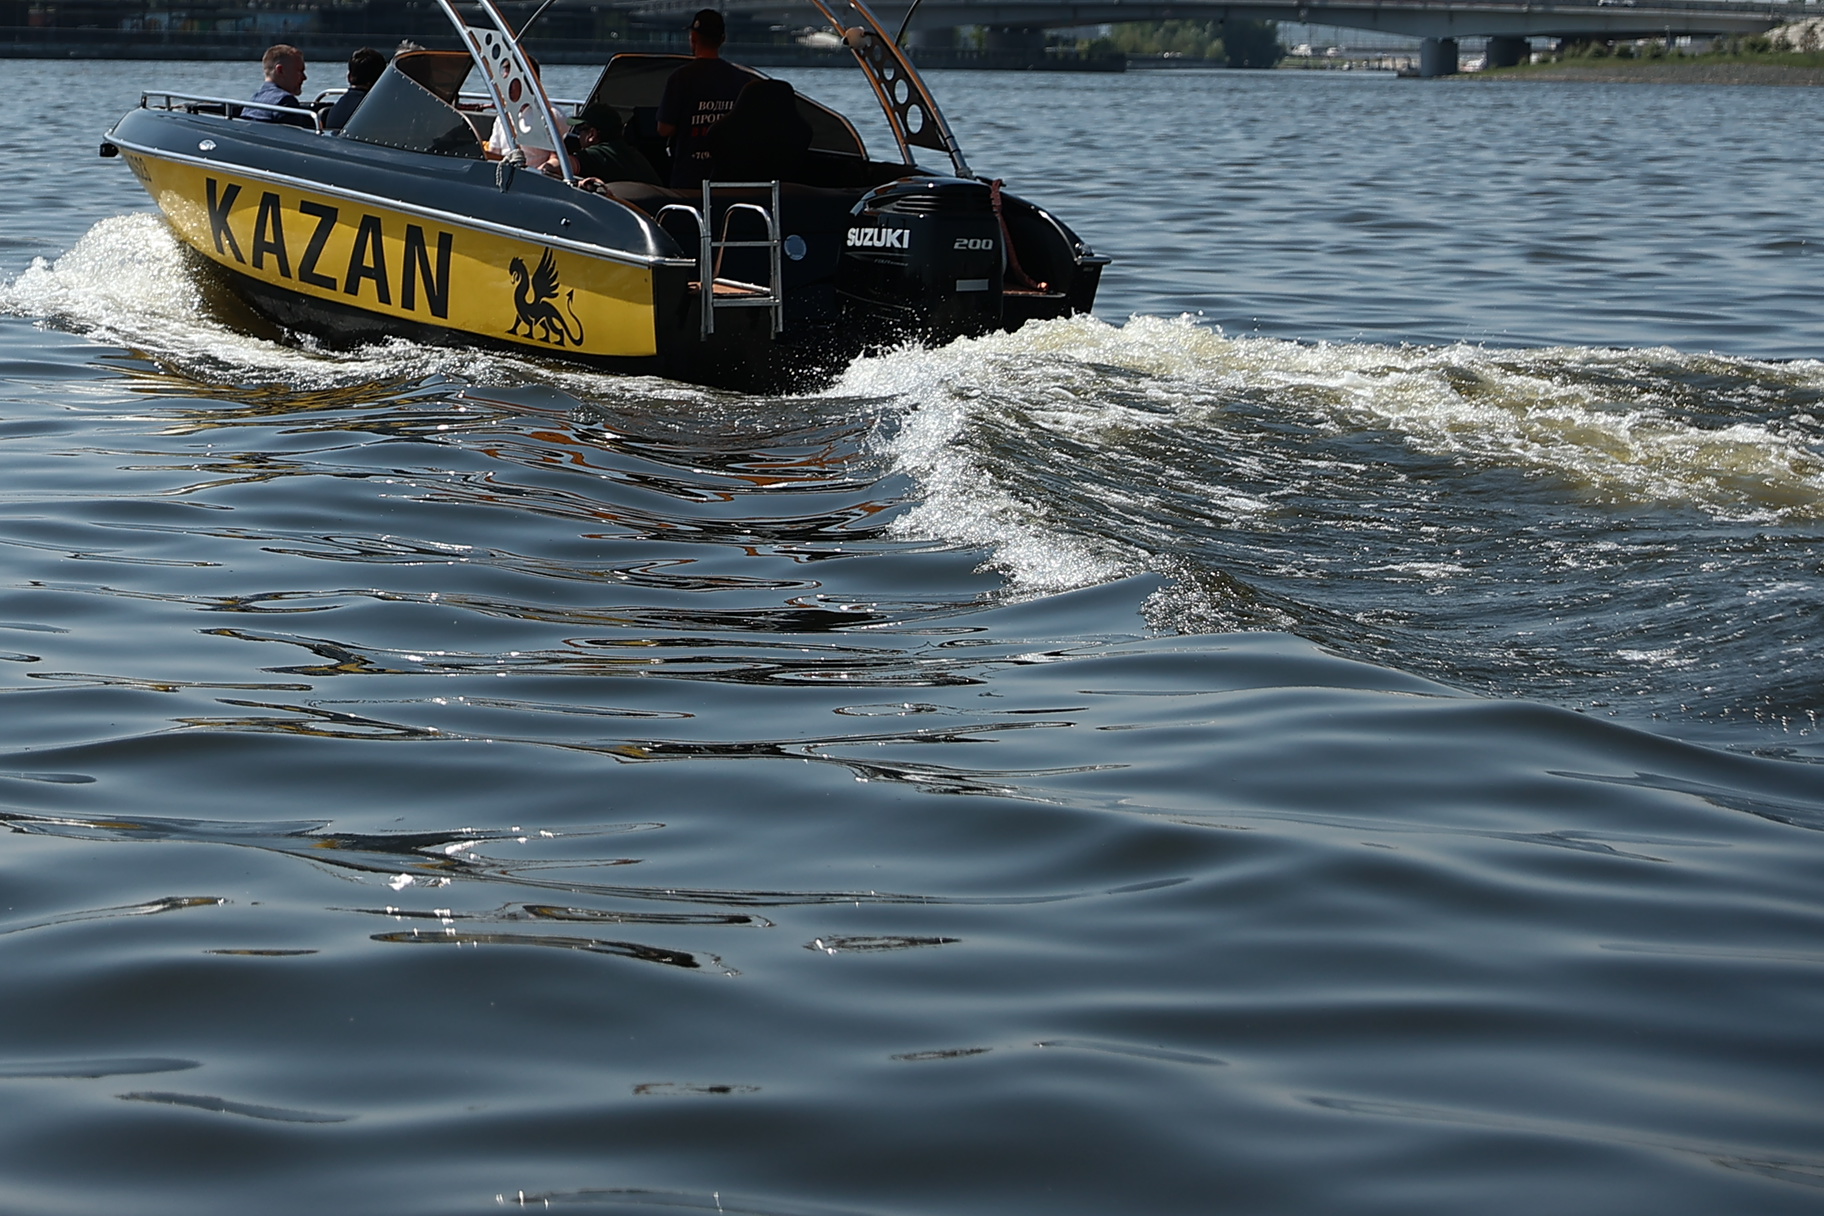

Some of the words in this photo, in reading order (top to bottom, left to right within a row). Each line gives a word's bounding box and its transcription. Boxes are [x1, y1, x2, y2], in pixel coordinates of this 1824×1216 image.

[205, 177, 454, 320] KAZAN
[846, 227, 911, 249] SUZUKI
[953, 238, 994, 250] 200
